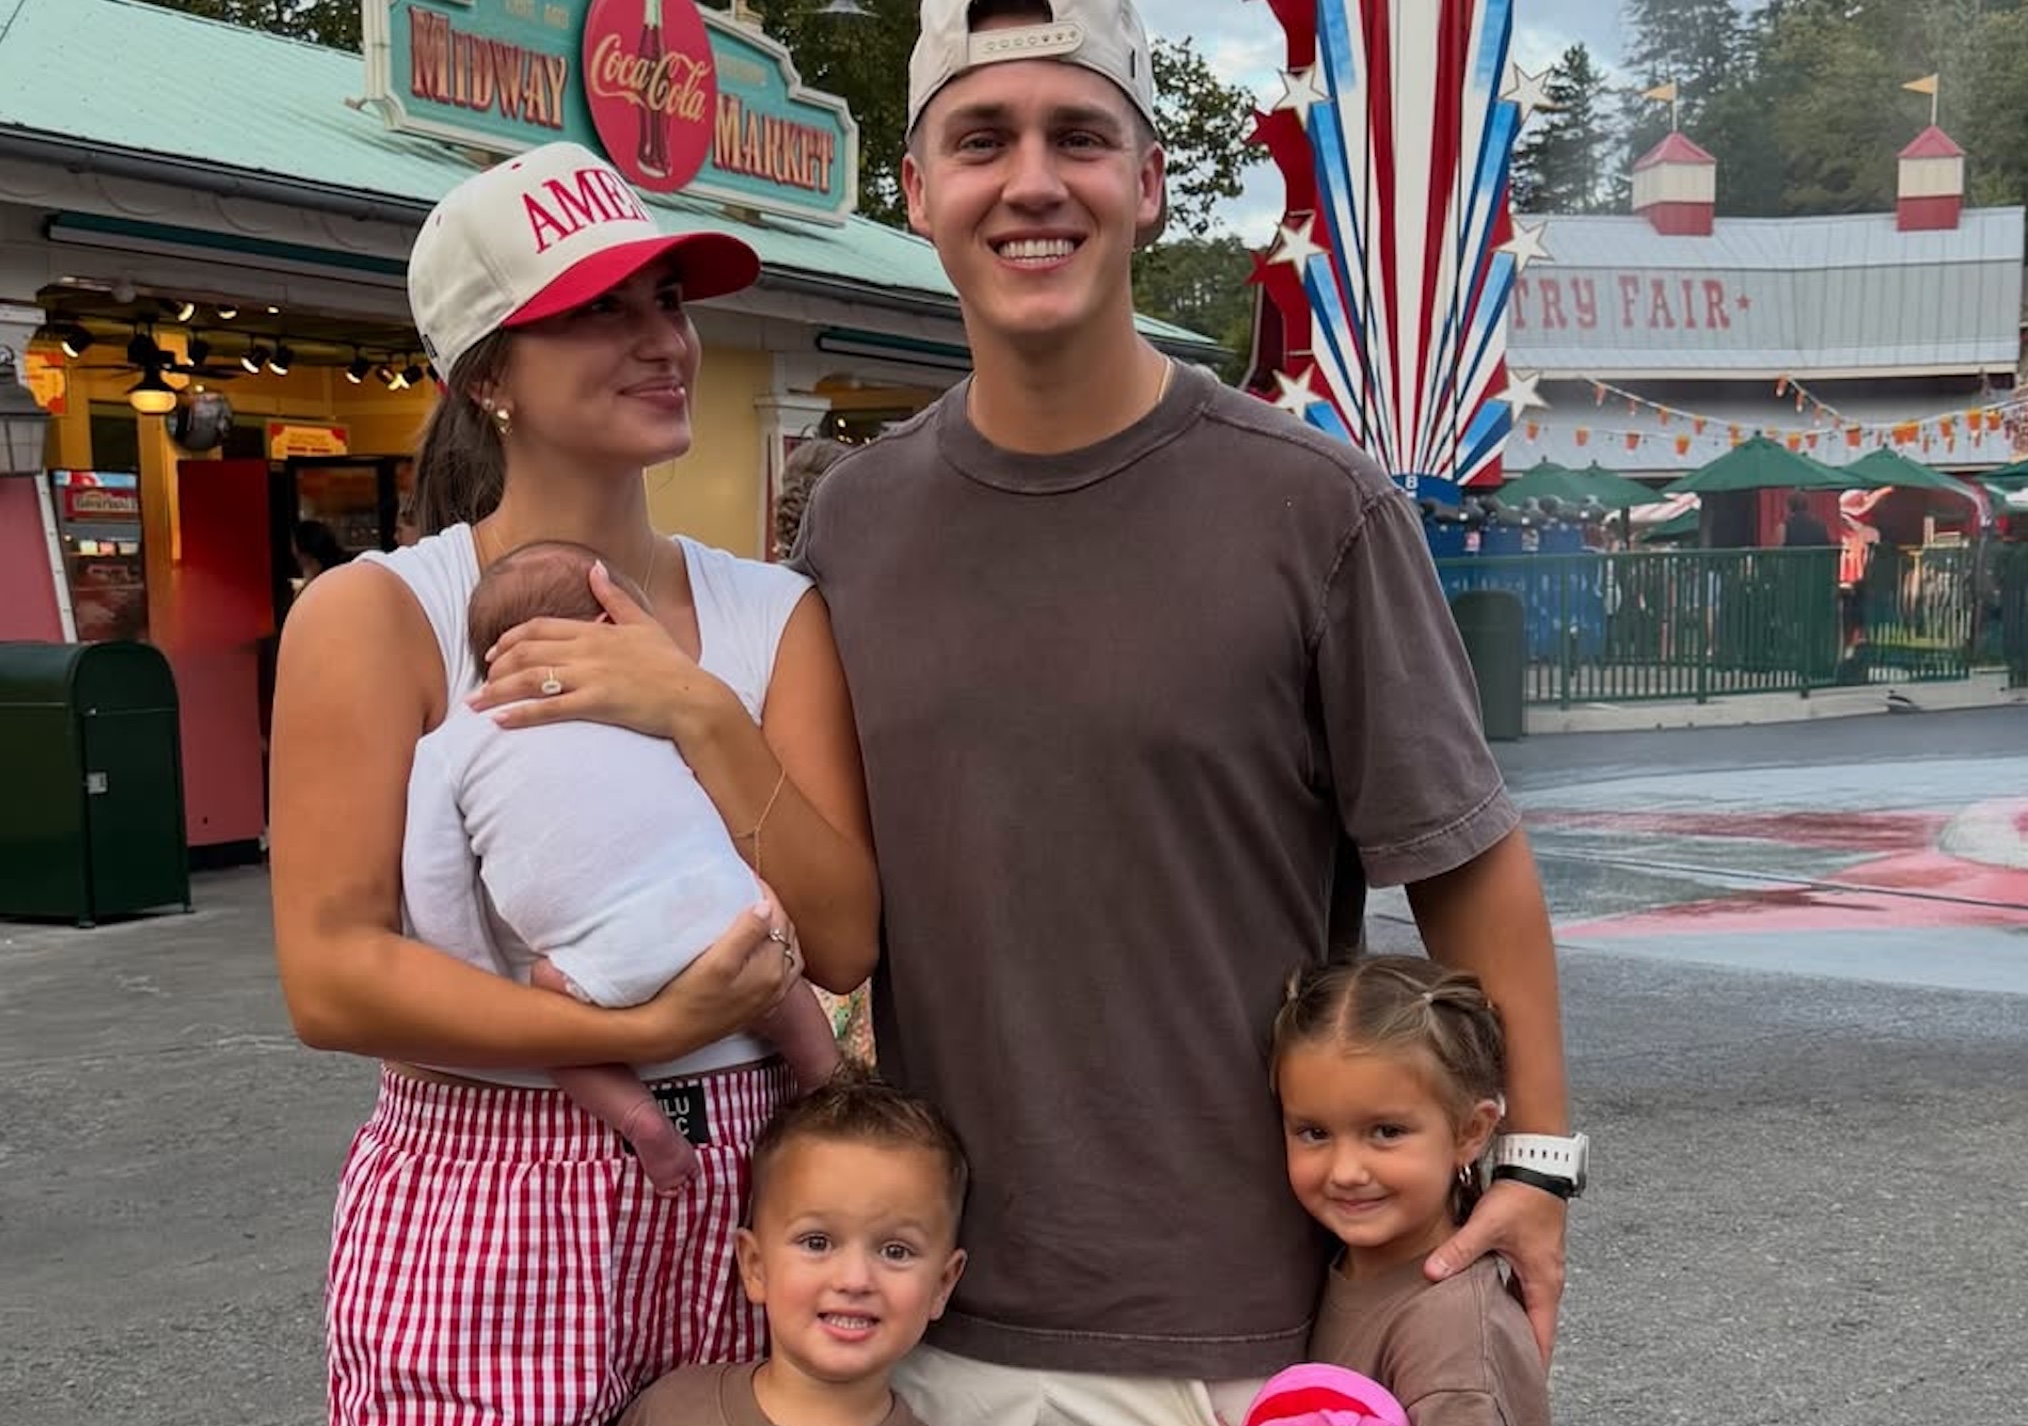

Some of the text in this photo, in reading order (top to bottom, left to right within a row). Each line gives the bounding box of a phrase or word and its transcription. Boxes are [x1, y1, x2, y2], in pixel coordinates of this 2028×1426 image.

[410, 8, 567, 130] MIDWAY
[590, 33, 713, 123] Coca-Cola
[713, 92, 835, 194] MARKET
[1512, 275, 1731, 329] TRY FAIR
